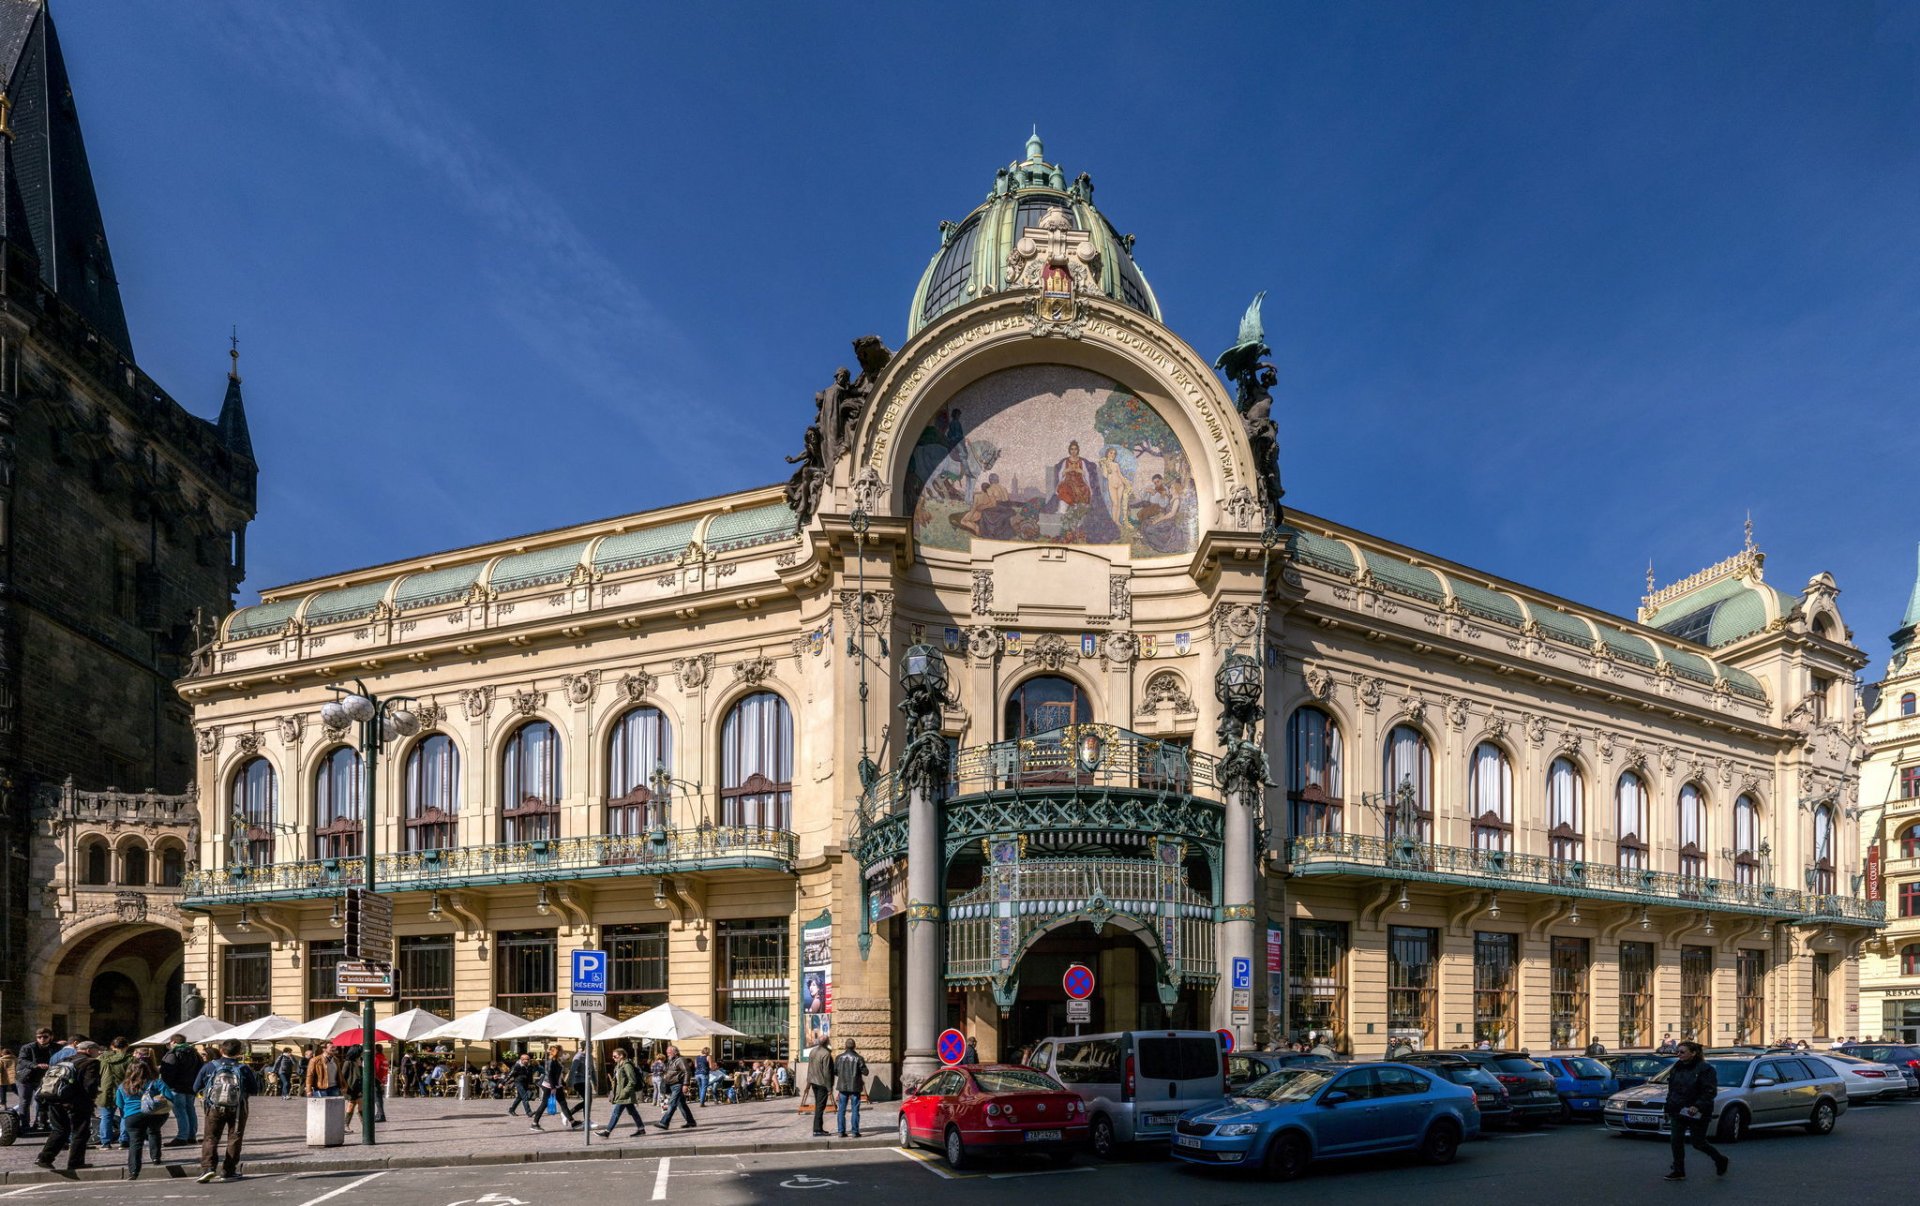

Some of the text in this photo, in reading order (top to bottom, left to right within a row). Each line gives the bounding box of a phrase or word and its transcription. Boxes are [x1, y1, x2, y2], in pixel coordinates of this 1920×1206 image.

[1086, 318, 1113, 336] JAK
[579, 956, 598, 979] P
[1236, 961, 1246, 978] P
[574, 998, 602, 1007] 3 MÍSTA
